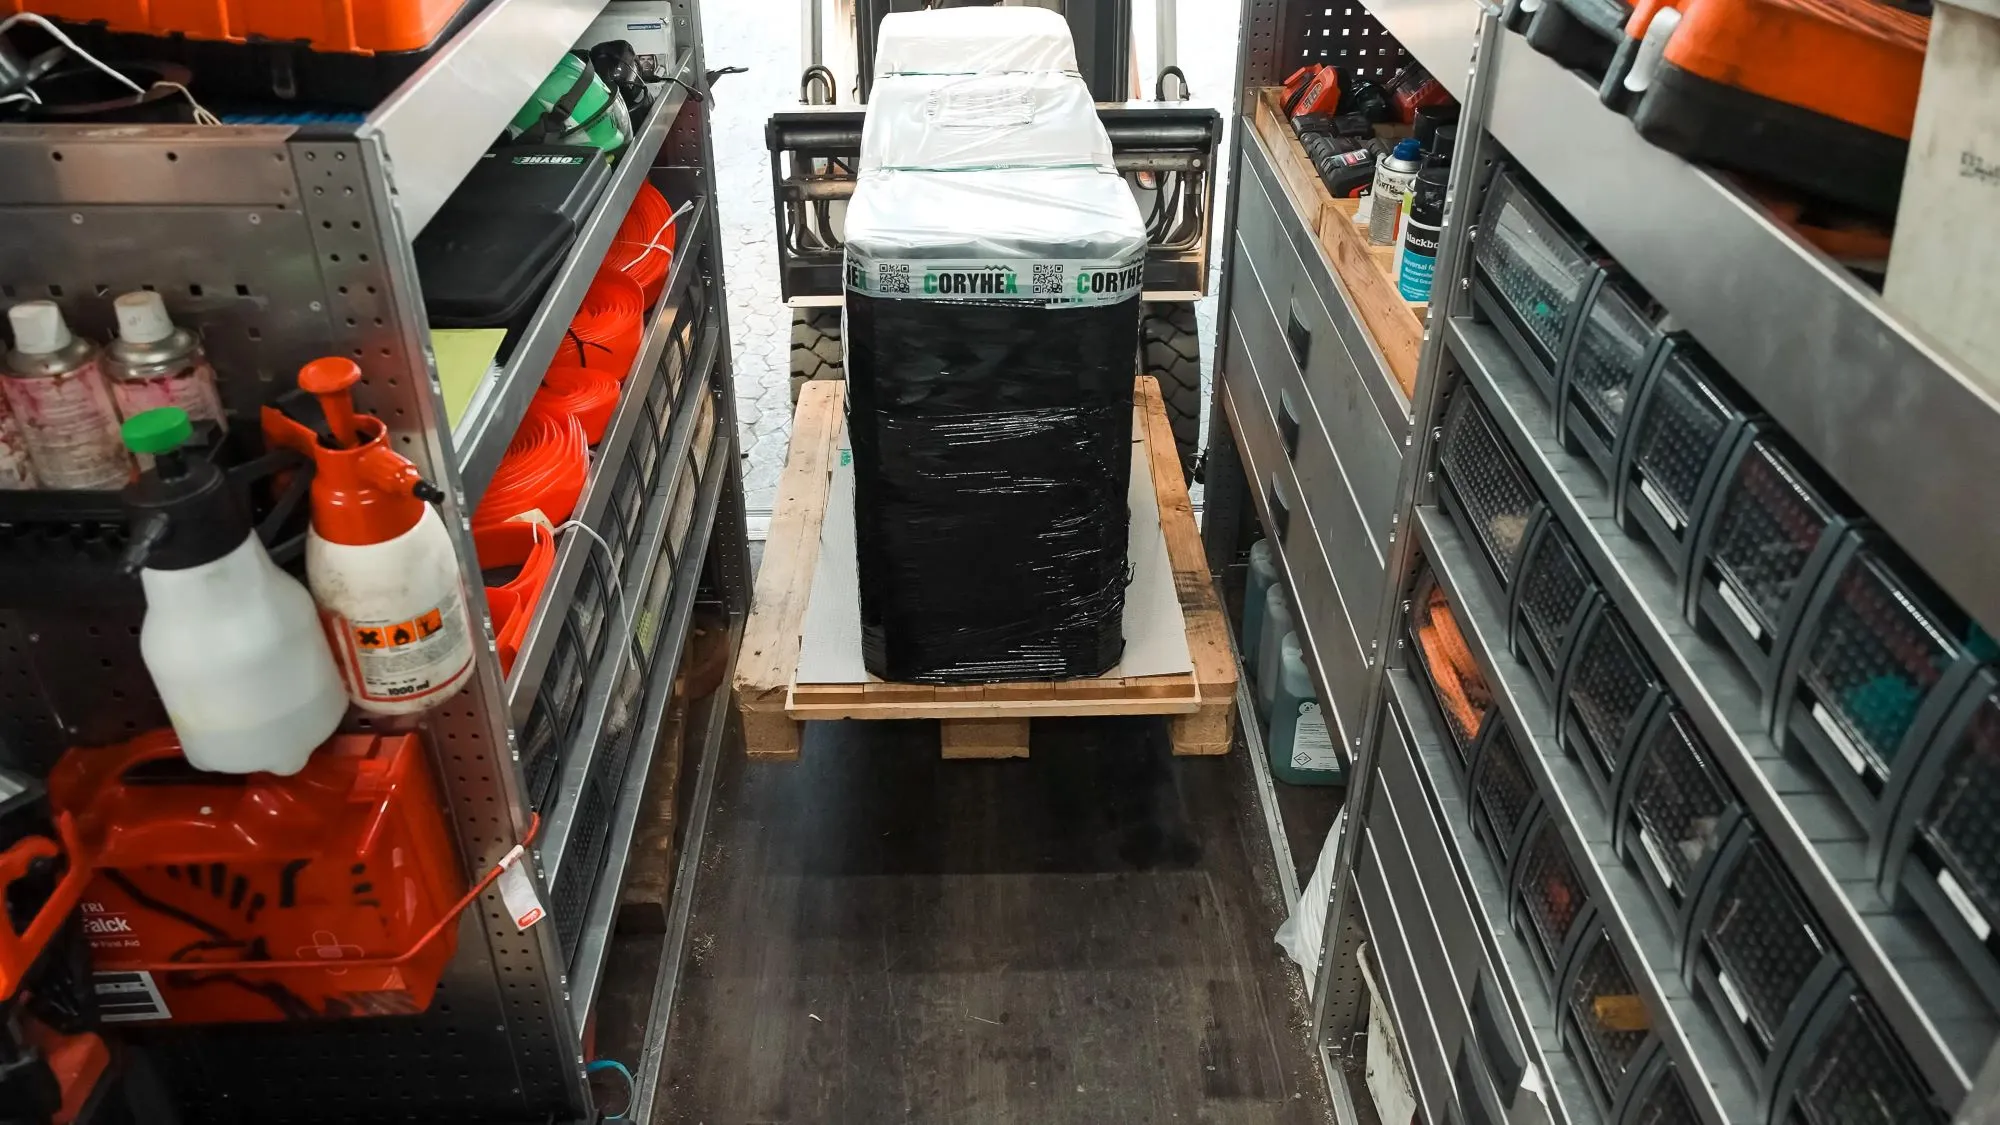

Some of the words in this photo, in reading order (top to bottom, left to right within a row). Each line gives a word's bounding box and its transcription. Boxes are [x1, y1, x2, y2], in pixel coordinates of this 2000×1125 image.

[924, 273, 1017, 294] CORYHEX
[388, 685, 415, 696] 1000
[416, 680, 430, 691] ml
